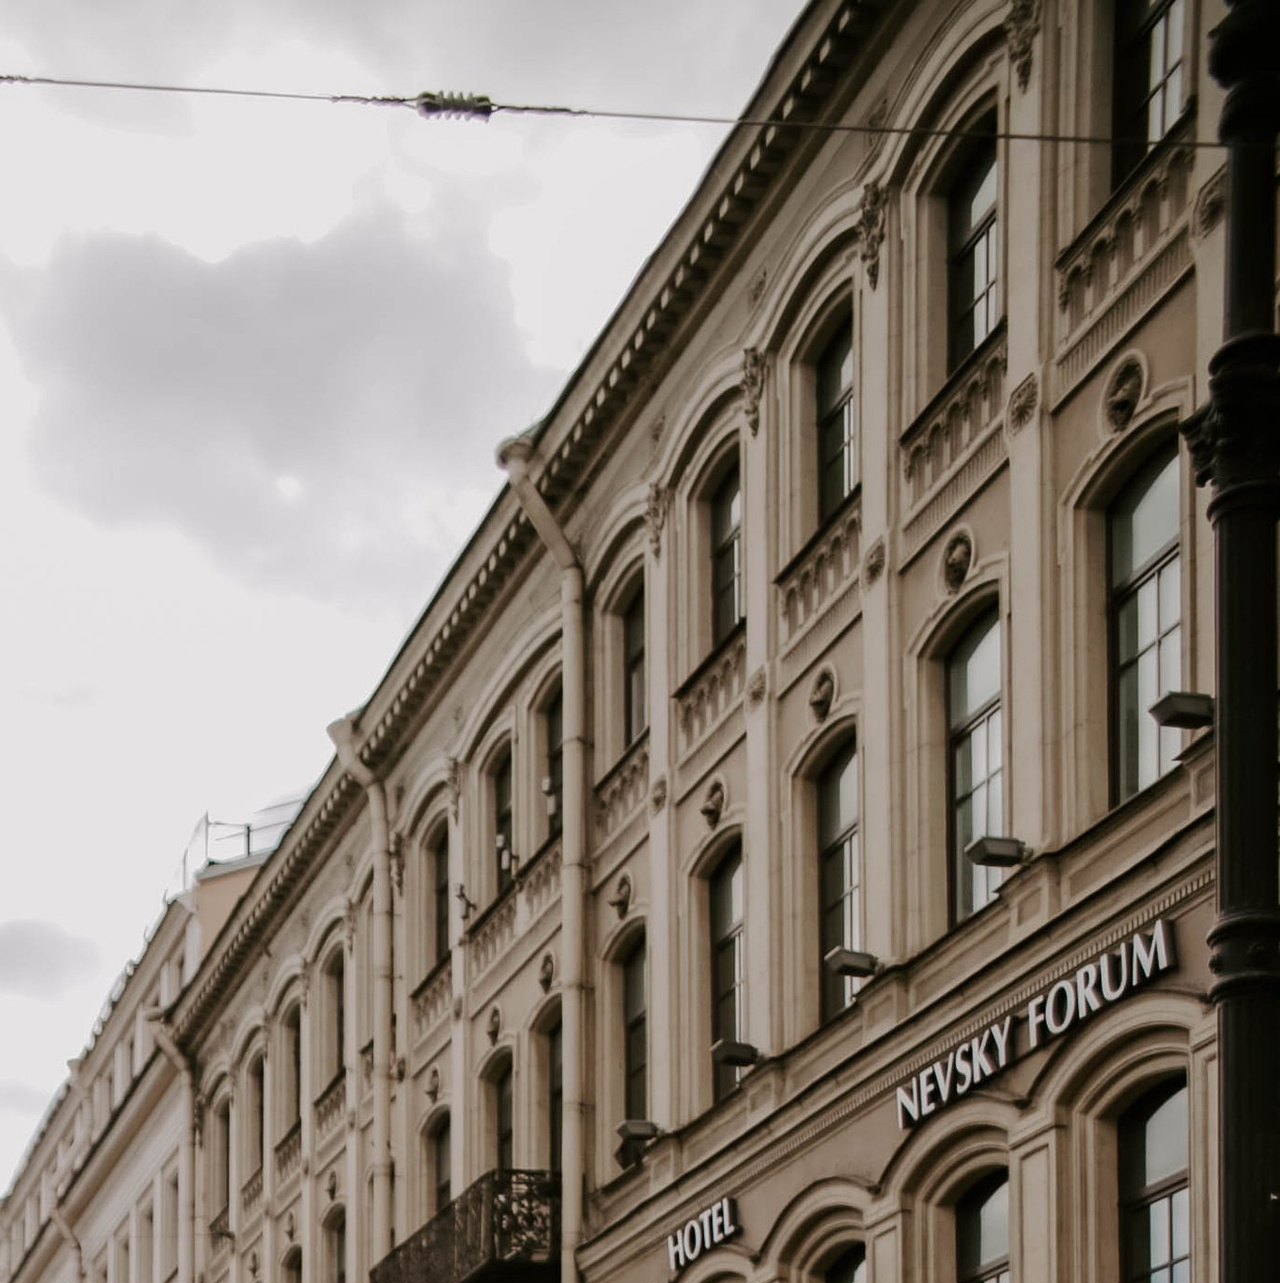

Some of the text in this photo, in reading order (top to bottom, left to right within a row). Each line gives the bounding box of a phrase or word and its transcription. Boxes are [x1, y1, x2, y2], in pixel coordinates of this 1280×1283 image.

[896, 918, 1168, 1130] NEVSKY FORUM
[667, 1196, 735, 1271] HOTEL
